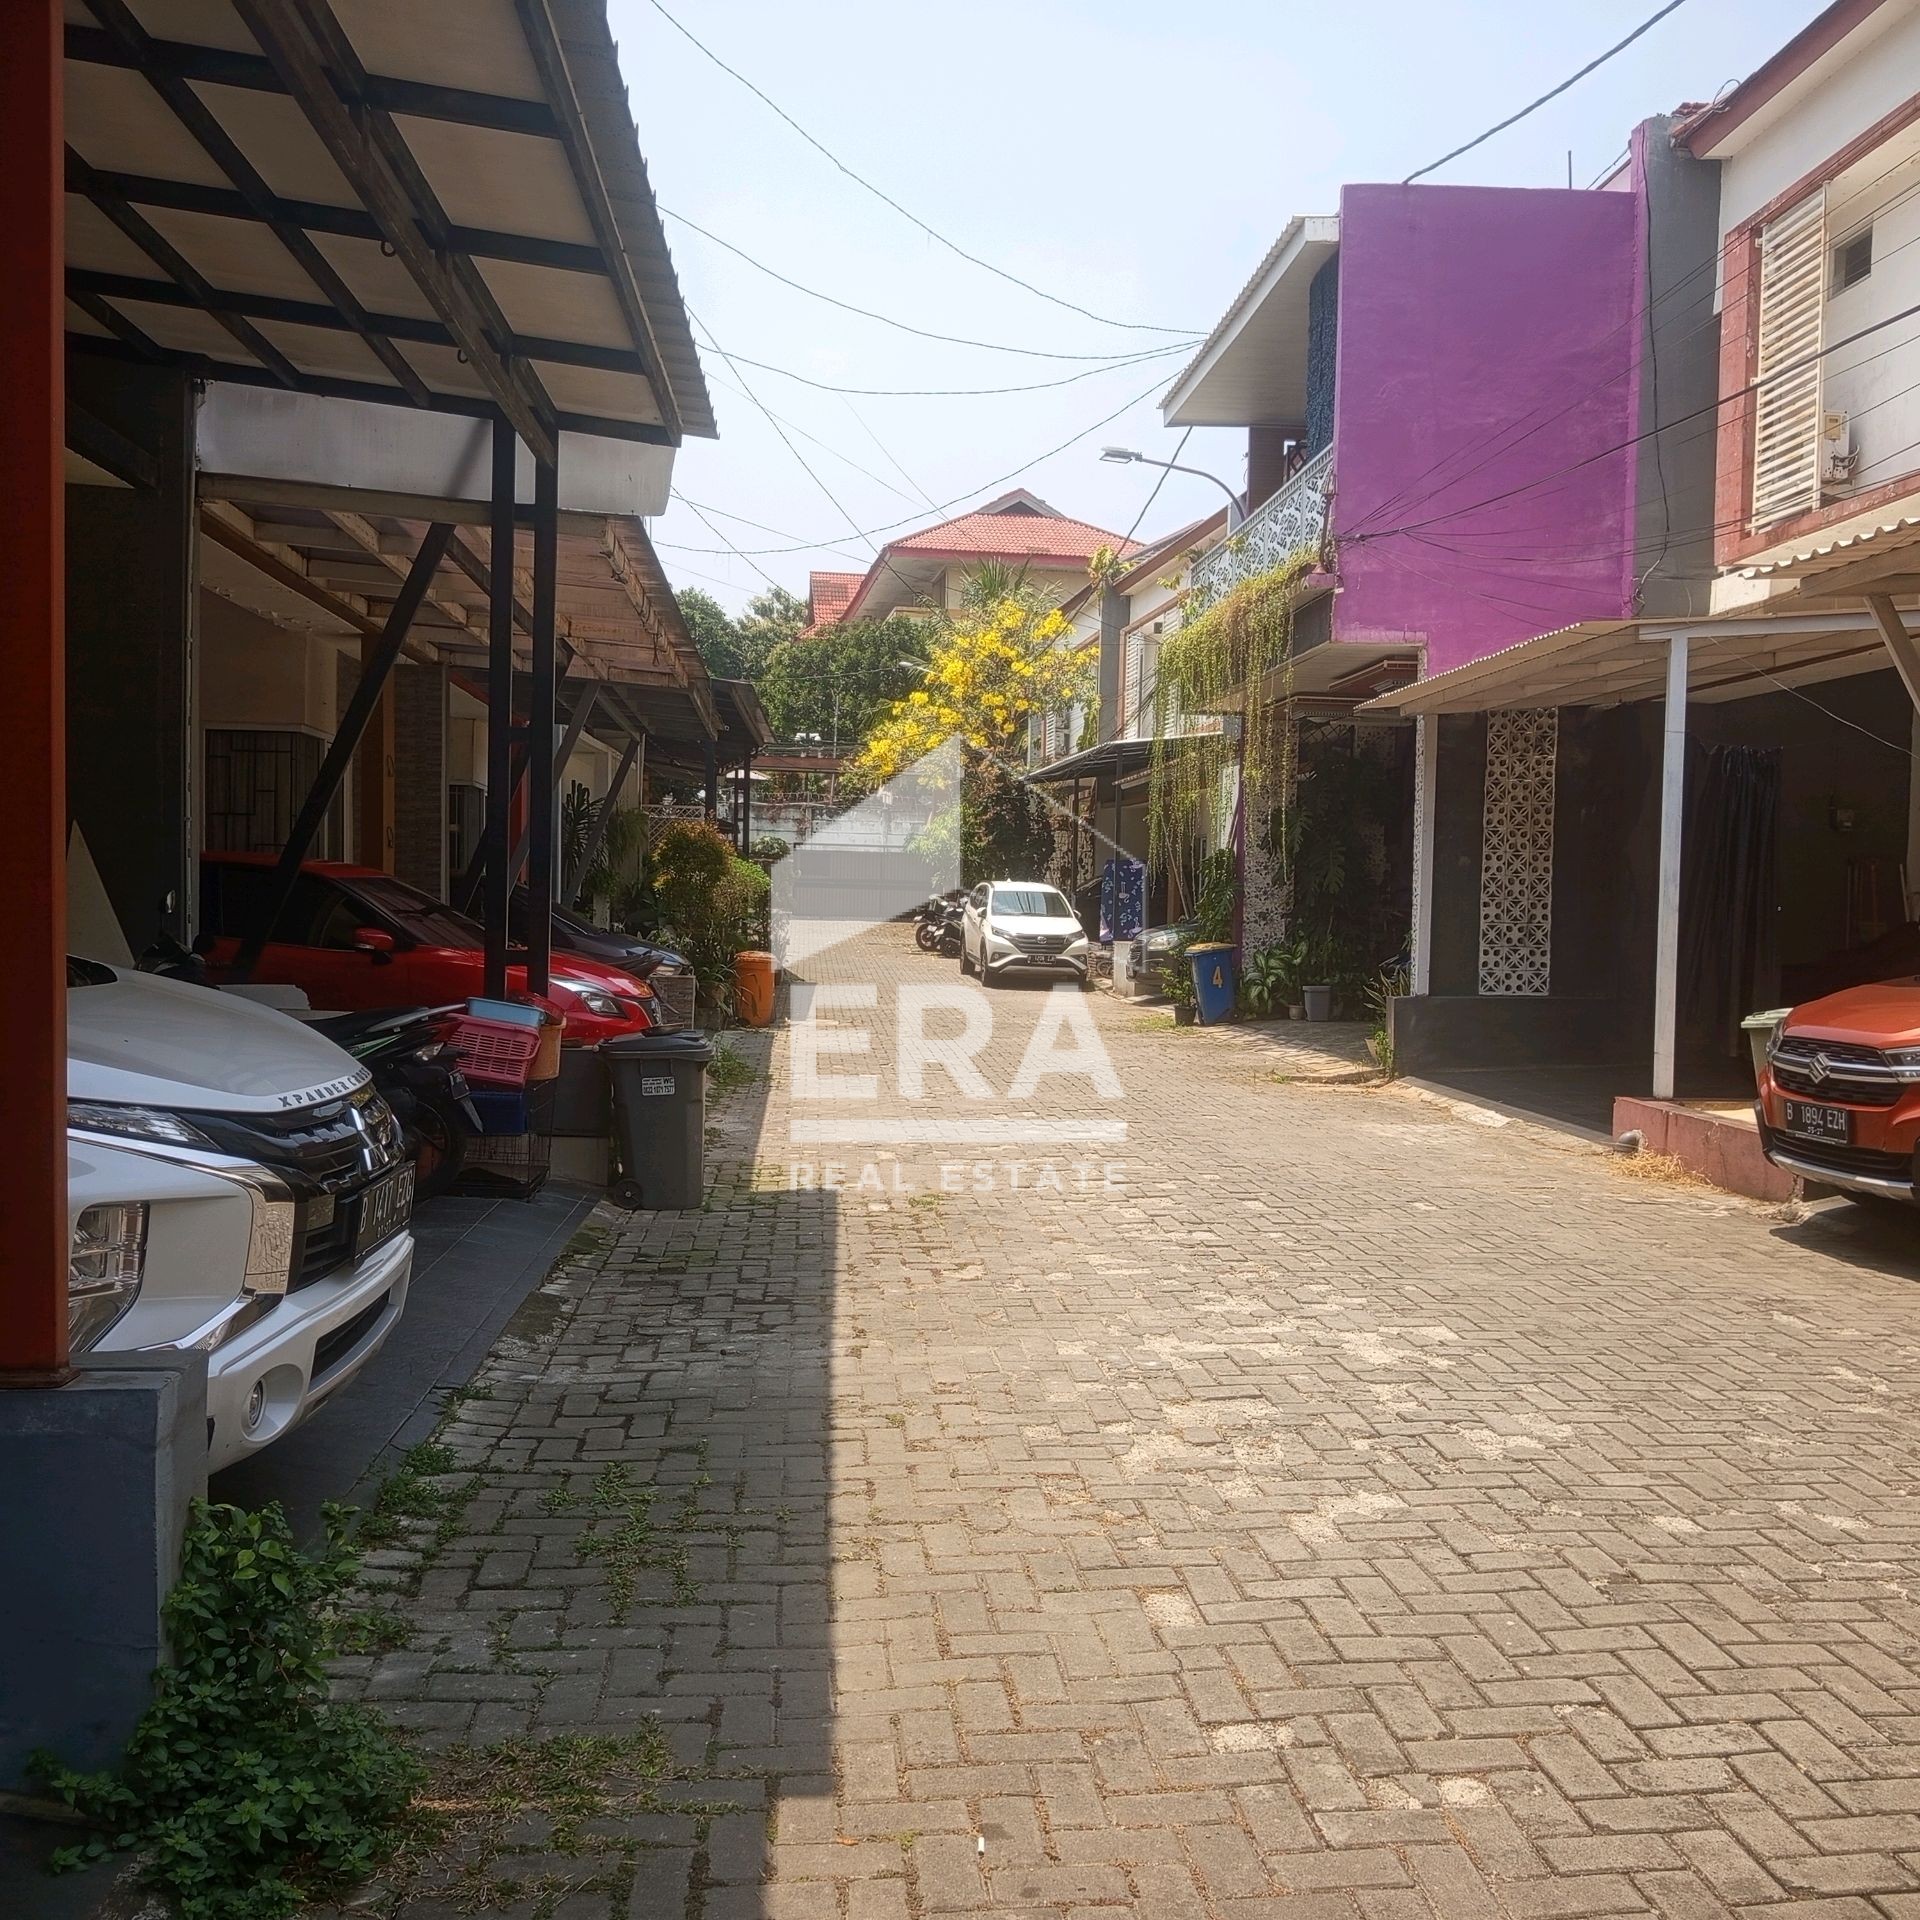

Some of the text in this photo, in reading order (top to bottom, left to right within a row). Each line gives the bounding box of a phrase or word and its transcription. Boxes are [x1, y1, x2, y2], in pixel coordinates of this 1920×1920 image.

[1212, 965, 1223, 988] 4
[278, 1081, 350, 1108] XPANDER
[1786, 1102, 1845, 1131] B 1894 EZH
[360, 1196, 369, 1234] B
